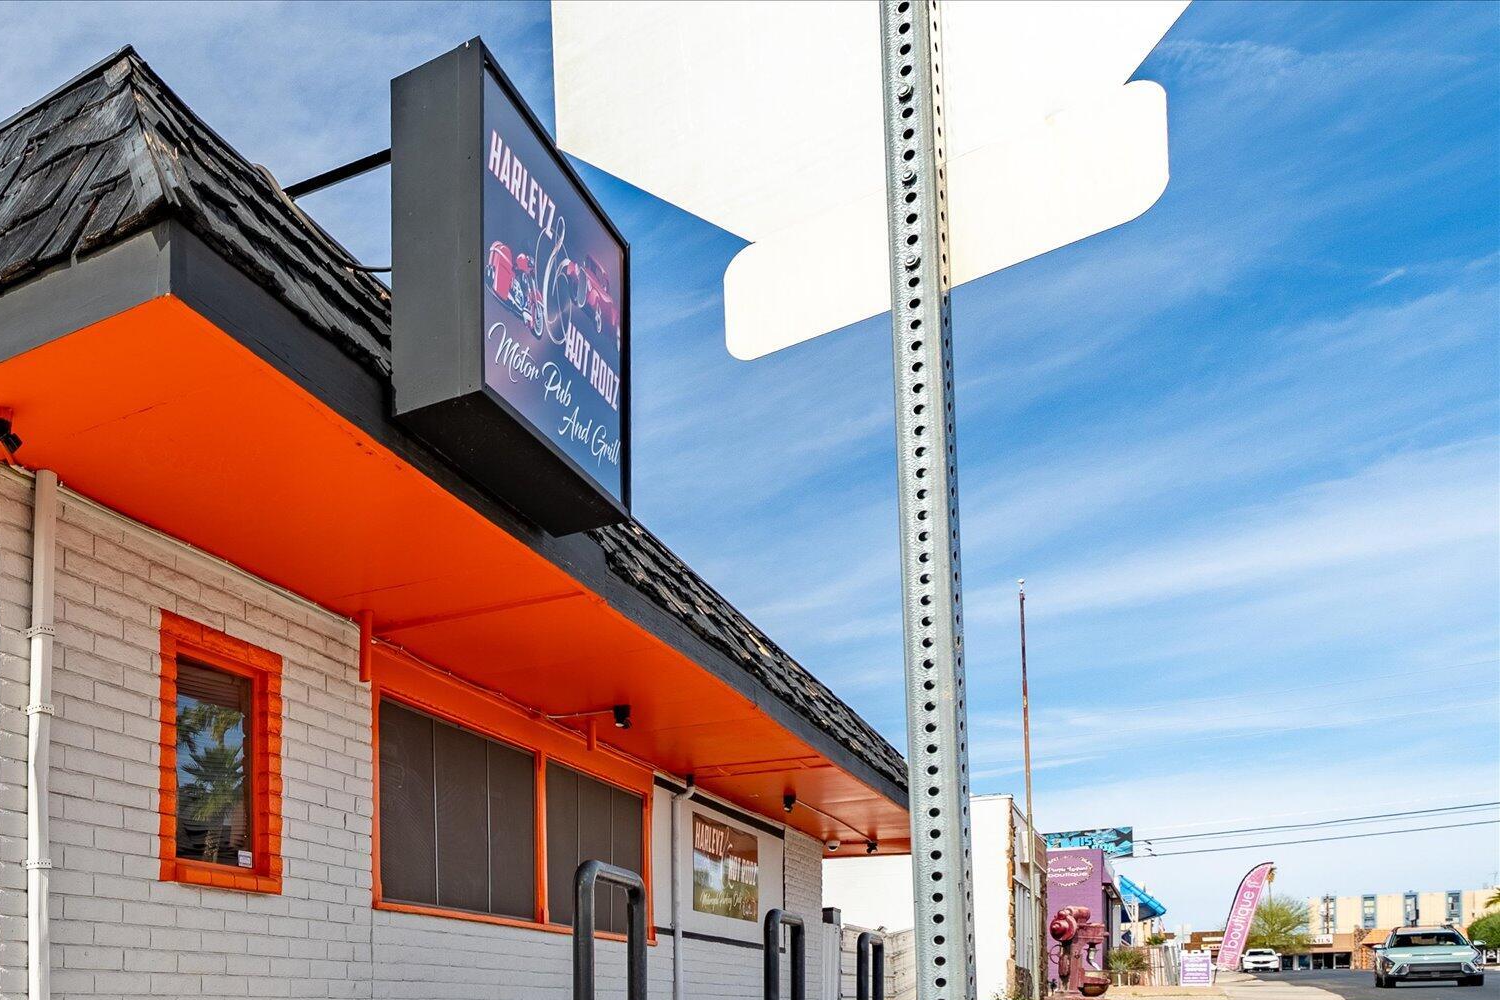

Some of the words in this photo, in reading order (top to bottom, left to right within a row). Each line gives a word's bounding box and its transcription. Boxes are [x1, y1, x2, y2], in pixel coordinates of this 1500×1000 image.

[488, 129, 556, 239] HARLEYZ
[488, 322, 540, 384] Motor
[542, 362, 572, 407] Pub
[564, 322, 591, 378] HOT
[590, 354, 621, 410] RODZ
[558, 406, 589, 445] And
[591, 425, 621, 467] Grill
[695, 821, 724, 857] HARLEYZ
[728, 854, 741, 882] HOT
[1225, 891, 1255, 948] boutique
